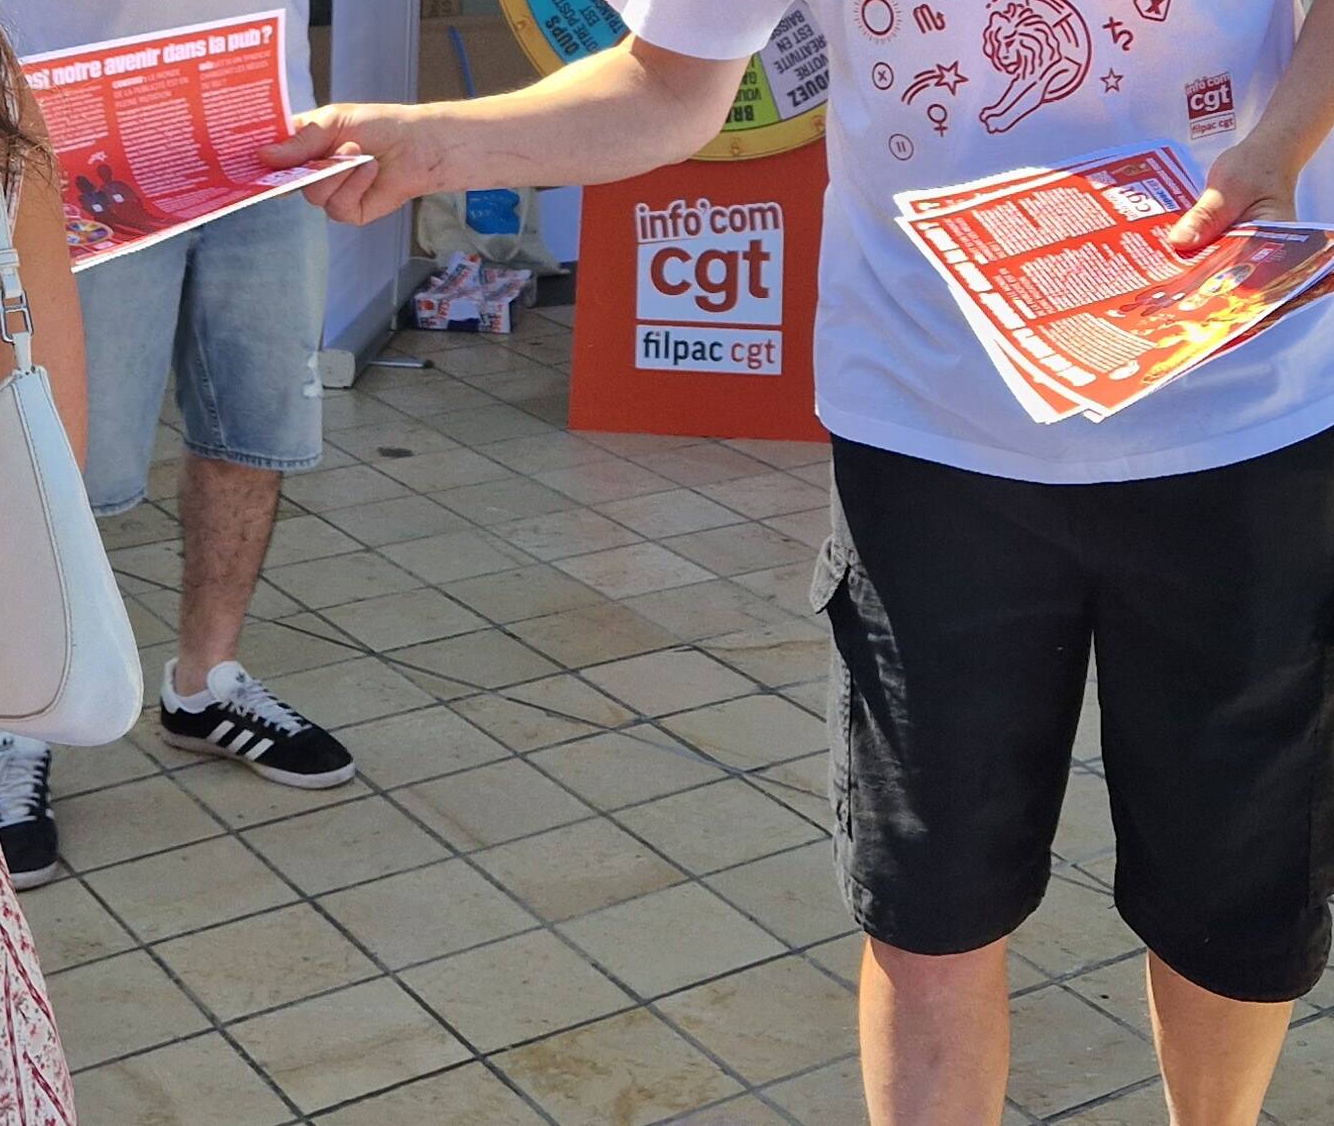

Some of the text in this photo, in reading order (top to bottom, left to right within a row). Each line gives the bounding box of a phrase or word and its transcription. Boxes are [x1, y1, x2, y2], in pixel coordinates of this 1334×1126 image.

[545, 14, 580, 55] OUPS
[580, 6, 601, 25] EST
[51, 60, 102, 86] notre
[104, 47, 162, 76] avenir
[163, 39, 207, 64] dans
[208, 35, 225, 55] la
[228, 28, 261, 52] pub
[262, 25, 273, 44] ?
[574, 22, 599, 54] OTRE
[774, 34, 827, 74] REATIVITE
[775, 24, 815, 53] EST EN
[796, 53, 829, 81] VOTRE
[1190, 85, 1230, 111] cgt
[638, 200, 780, 240] info'com
[650, 239, 770, 313] cgt
[643, 331, 775, 369] filpac cgt
